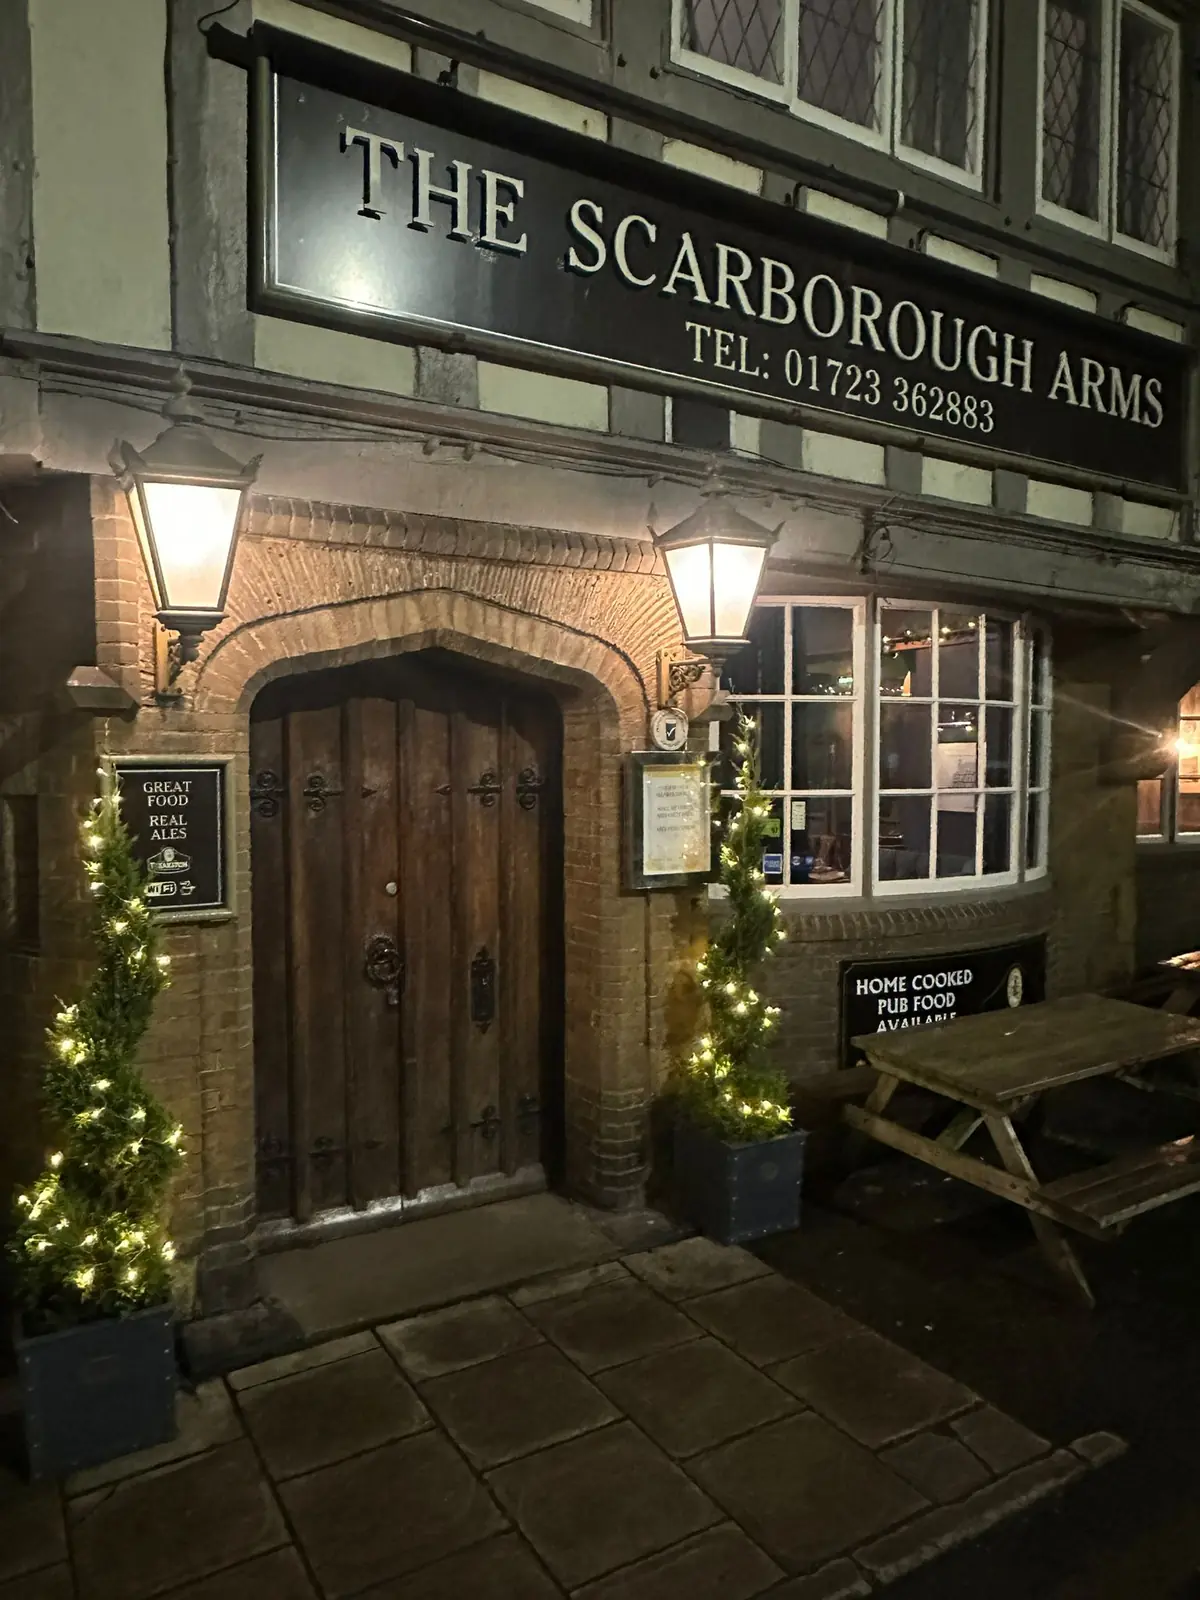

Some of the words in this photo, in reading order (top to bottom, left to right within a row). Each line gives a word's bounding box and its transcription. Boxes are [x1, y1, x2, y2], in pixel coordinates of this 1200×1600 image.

[341, 126, 527, 255] THE
[568, 199, 1034, 393] SCARBOROUGH
[1048, 350, 1164, 429] ARMS
[686, 321, 770, 380] TEL:
[784, 348, 881, 405] 01723
[893, 376, 994, 433] 362883
[143, 781, 192, 793] GREAT
[147, 794, 189, 807] FOOD
[149, 814, 188, 827] REAL
[150, 828, 187, 841] ALES
[856, 976, 907, 996] HOME
[912, 969, 973, 991] COOKED
[877, 997, 909, 1015] PUB
[913, 992, 956, 1012] FOOD
